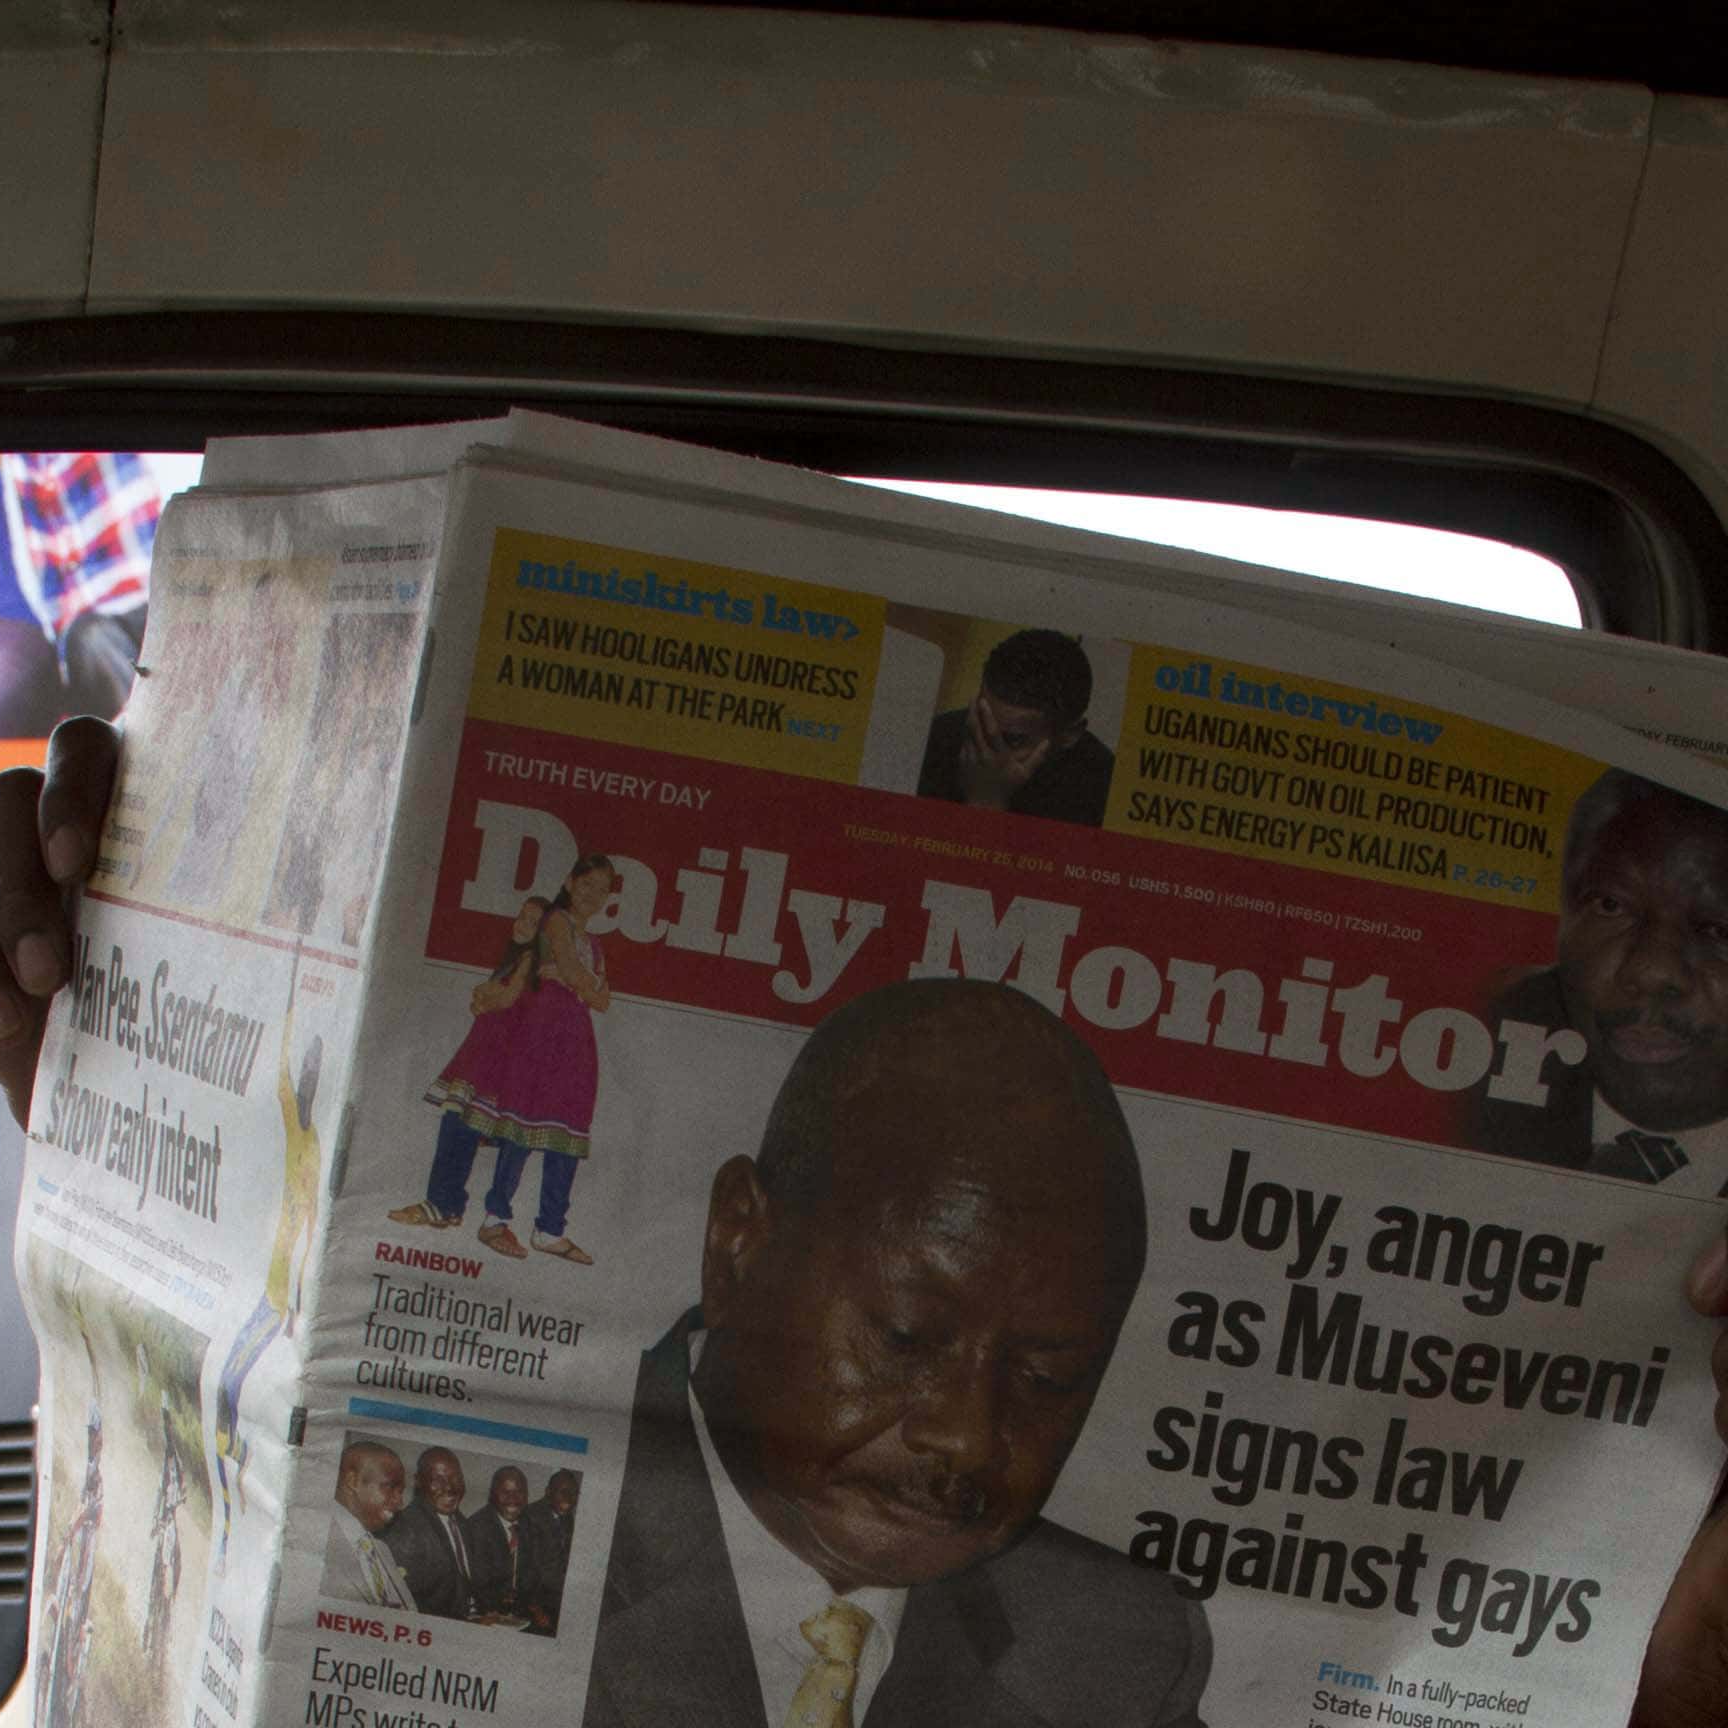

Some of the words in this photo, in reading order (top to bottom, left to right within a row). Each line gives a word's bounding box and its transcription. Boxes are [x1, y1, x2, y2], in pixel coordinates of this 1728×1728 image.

[515, 560, 755, 625] miniskirts
[496, 653, 516, 686] A
[517, 657, 625, 704] WOMAN
[625, 675, 658, 710] AT
[660, 681, 715, 719] THE
[715, 690, 786, 731] PARK
[504, 611, 515, 641] I
[515, 612, 577, 652] SAW
[579, 623, 733, 678] HOOLIGANS
[732, 649, 860, 699] UNDRESS
[1153, 663, 1216, 700] oil
[1217, 670, 1444, 745] interview
[481, 750, 568, 785] TRUTH
[571, 766, 656, 800] EVERY
[658, 780, 712, 810] DAY
[1142, 704, 1292, 761] UGANDANS
[1291, 734, 1404, 784] SHOULD
[1403, 757, 1442, 791] BE
[1442, 764, 1552, 813] PATIENT
[1127, 790, 1199, 831] SAYS
[1198, 803, 1305, 851] ENERGY
[1306, 823, 1345, 858] PS
[1346, 830, 1451, 878] KALIISA
[1136, 748, 1209, 789] WITH
[1209, 761, 1283, 803] GOVT
[1285, 775, 1327, 811] ON
[1330, 784, 1373, 819] OIL
[1375, 792, 1553, 859] PRODUCTION,
[460, 799, 887, 1004] Daily
[908, 878, 1588, 1107] Monitor
[108, 945, 142, 1070] Pee,
[145, 959, 265, 1097] Ssentamu
[46, 1052, 111, 1166] show
[106, 1084, 153, 1212] early
[156, 1098, 223, 1224] intent
[374, 1241, 483, 1278] RAINBOW
[1189, 1149, 1347, 1281] Joy,
[1366, 1204, 1606, 1316] anger
[361, 1312, 426, 1355] from
[430, 1327, 548, 1380] different
[367, 1273, 512, 1332] Traditional
[518, 1311, 587, 1350] wear
[356, 1356, 474, 1401] cultures.
[1167, 1290, 1267, 1370] as
[1276, 1285, 1671, 1428] Museveni
[1146, 1392, 1366, 1507] signs
[1373, 1418, 1523, 1522] law
[1128, 1510, 1426, 1618] against
[1431, 1557, 1602, 1658] gays
[316, 1611, 388, 1642] NEWS,
[393, 1624, 411, 1643] P.
[415, 1628, 433, 1646] 6
[311, 1646, 426, 1699] Expelled
[431, 1668, 498, 1713] NRM
[1311, 1689, 1372, 1719] State
[1376, 1700, 1433, 1728] House
[1317, 1661, 1379, 1690] Firm.
[1387, 1672, 1404, 1694] In
[1405, 1681, 1417, 1697] a
[1420, 1678, 1531, 1715] fully-packed
